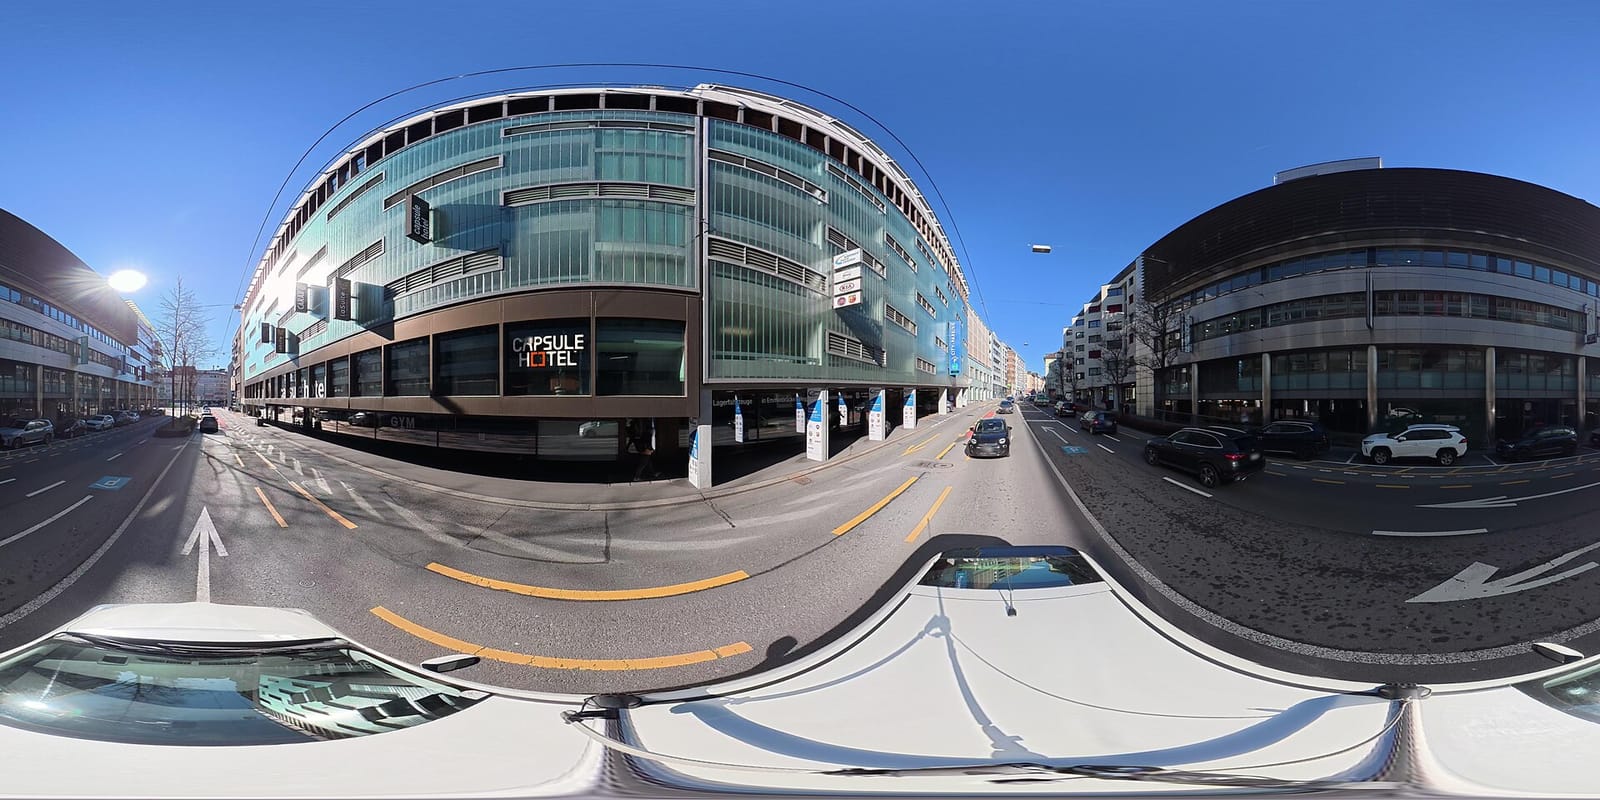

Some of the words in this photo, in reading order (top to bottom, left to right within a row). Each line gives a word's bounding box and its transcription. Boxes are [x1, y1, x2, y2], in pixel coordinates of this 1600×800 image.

[413, 204, 421, 235] capsule
[420, 217, 429, 240] hotel
[512, 334, 584, 352] CAPSULE
[519, 350, 577, 367] HOTEL
[712, 399, 753, 408] Lagerfahzeuge
[390, 415, 416, 429] GYM
